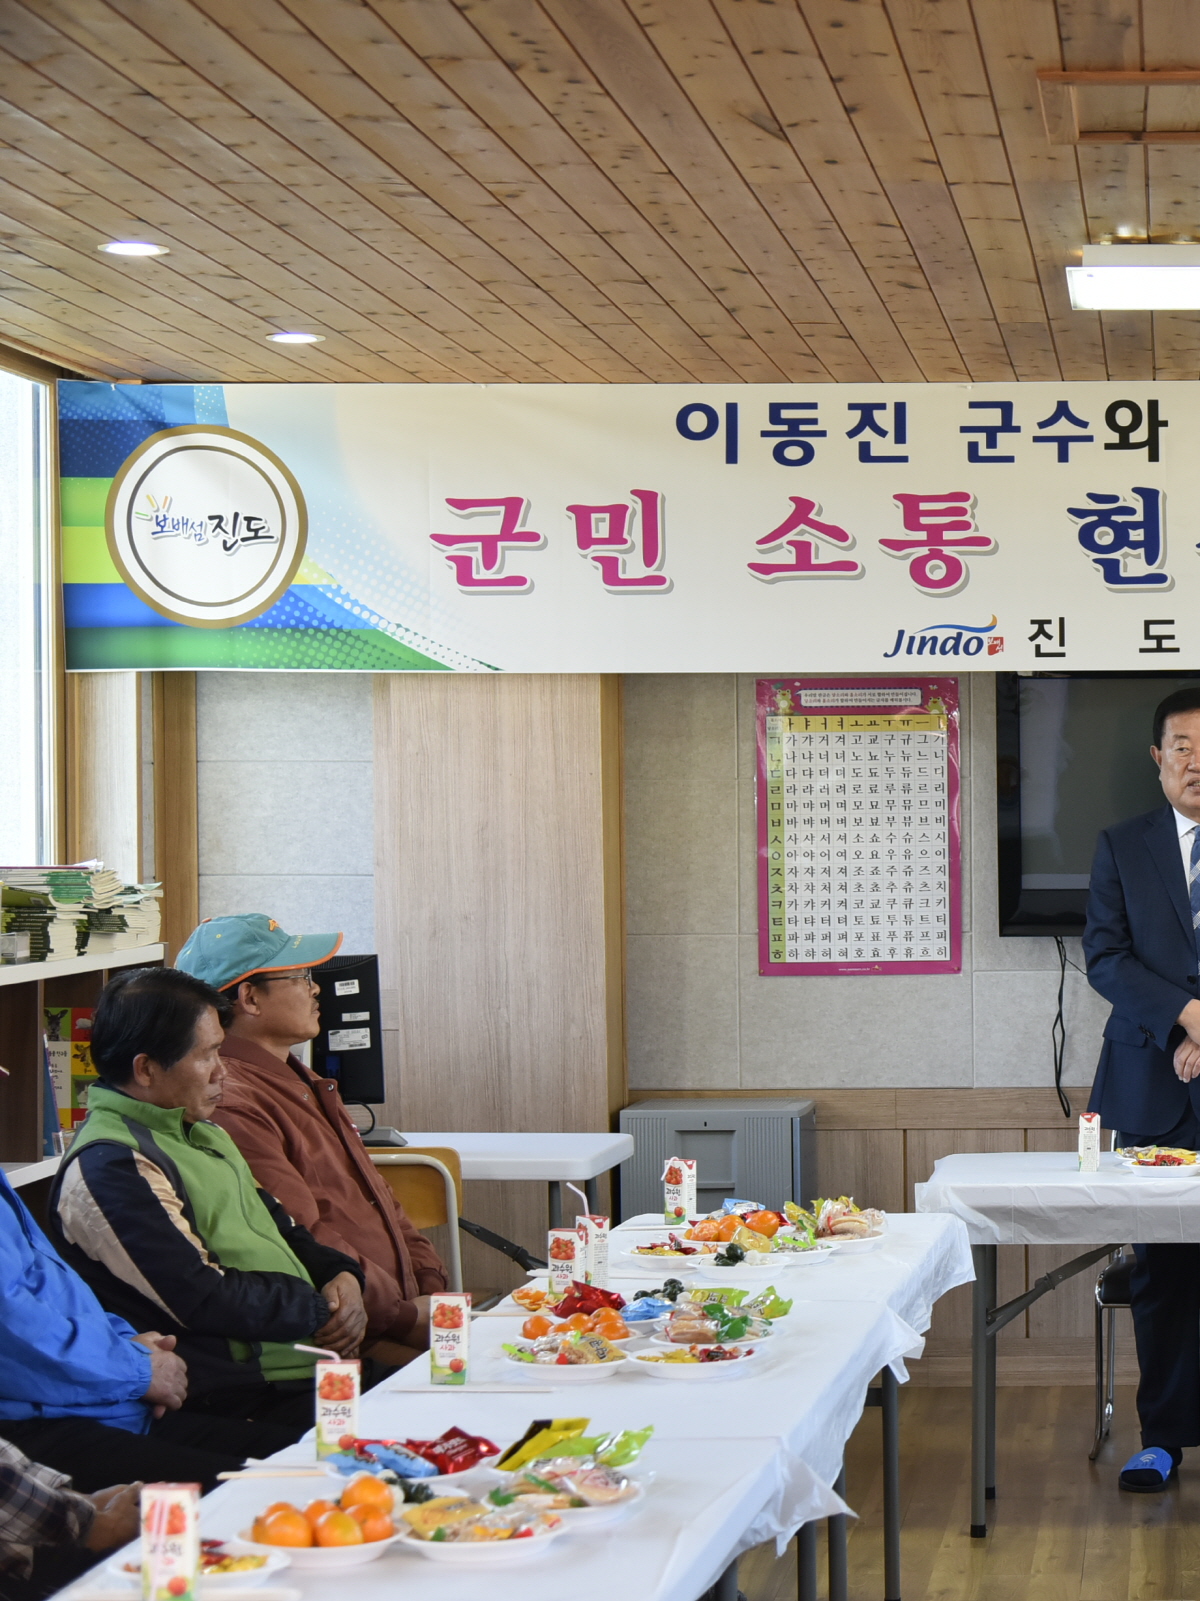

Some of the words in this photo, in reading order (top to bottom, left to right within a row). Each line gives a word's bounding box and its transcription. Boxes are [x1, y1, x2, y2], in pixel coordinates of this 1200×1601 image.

[675, 401, 909, 467] 이동진
[959, 399, 1169, 463] 군수와
[151, 514, 205, 541] 보배섬
[207, 511, 275, 551] 진도
[429, 489, 668, 588] 군민
[747, 491, 992, 589] 소통
[883, 629, 984, 658] Jindo
[665, 1186, 681, 1196] 과수원
[551, 1262, 573, 1274] 과수원
[434, 1331, 461, 1343] 과수원
[321, 1405, 352, 1418] 과수원
